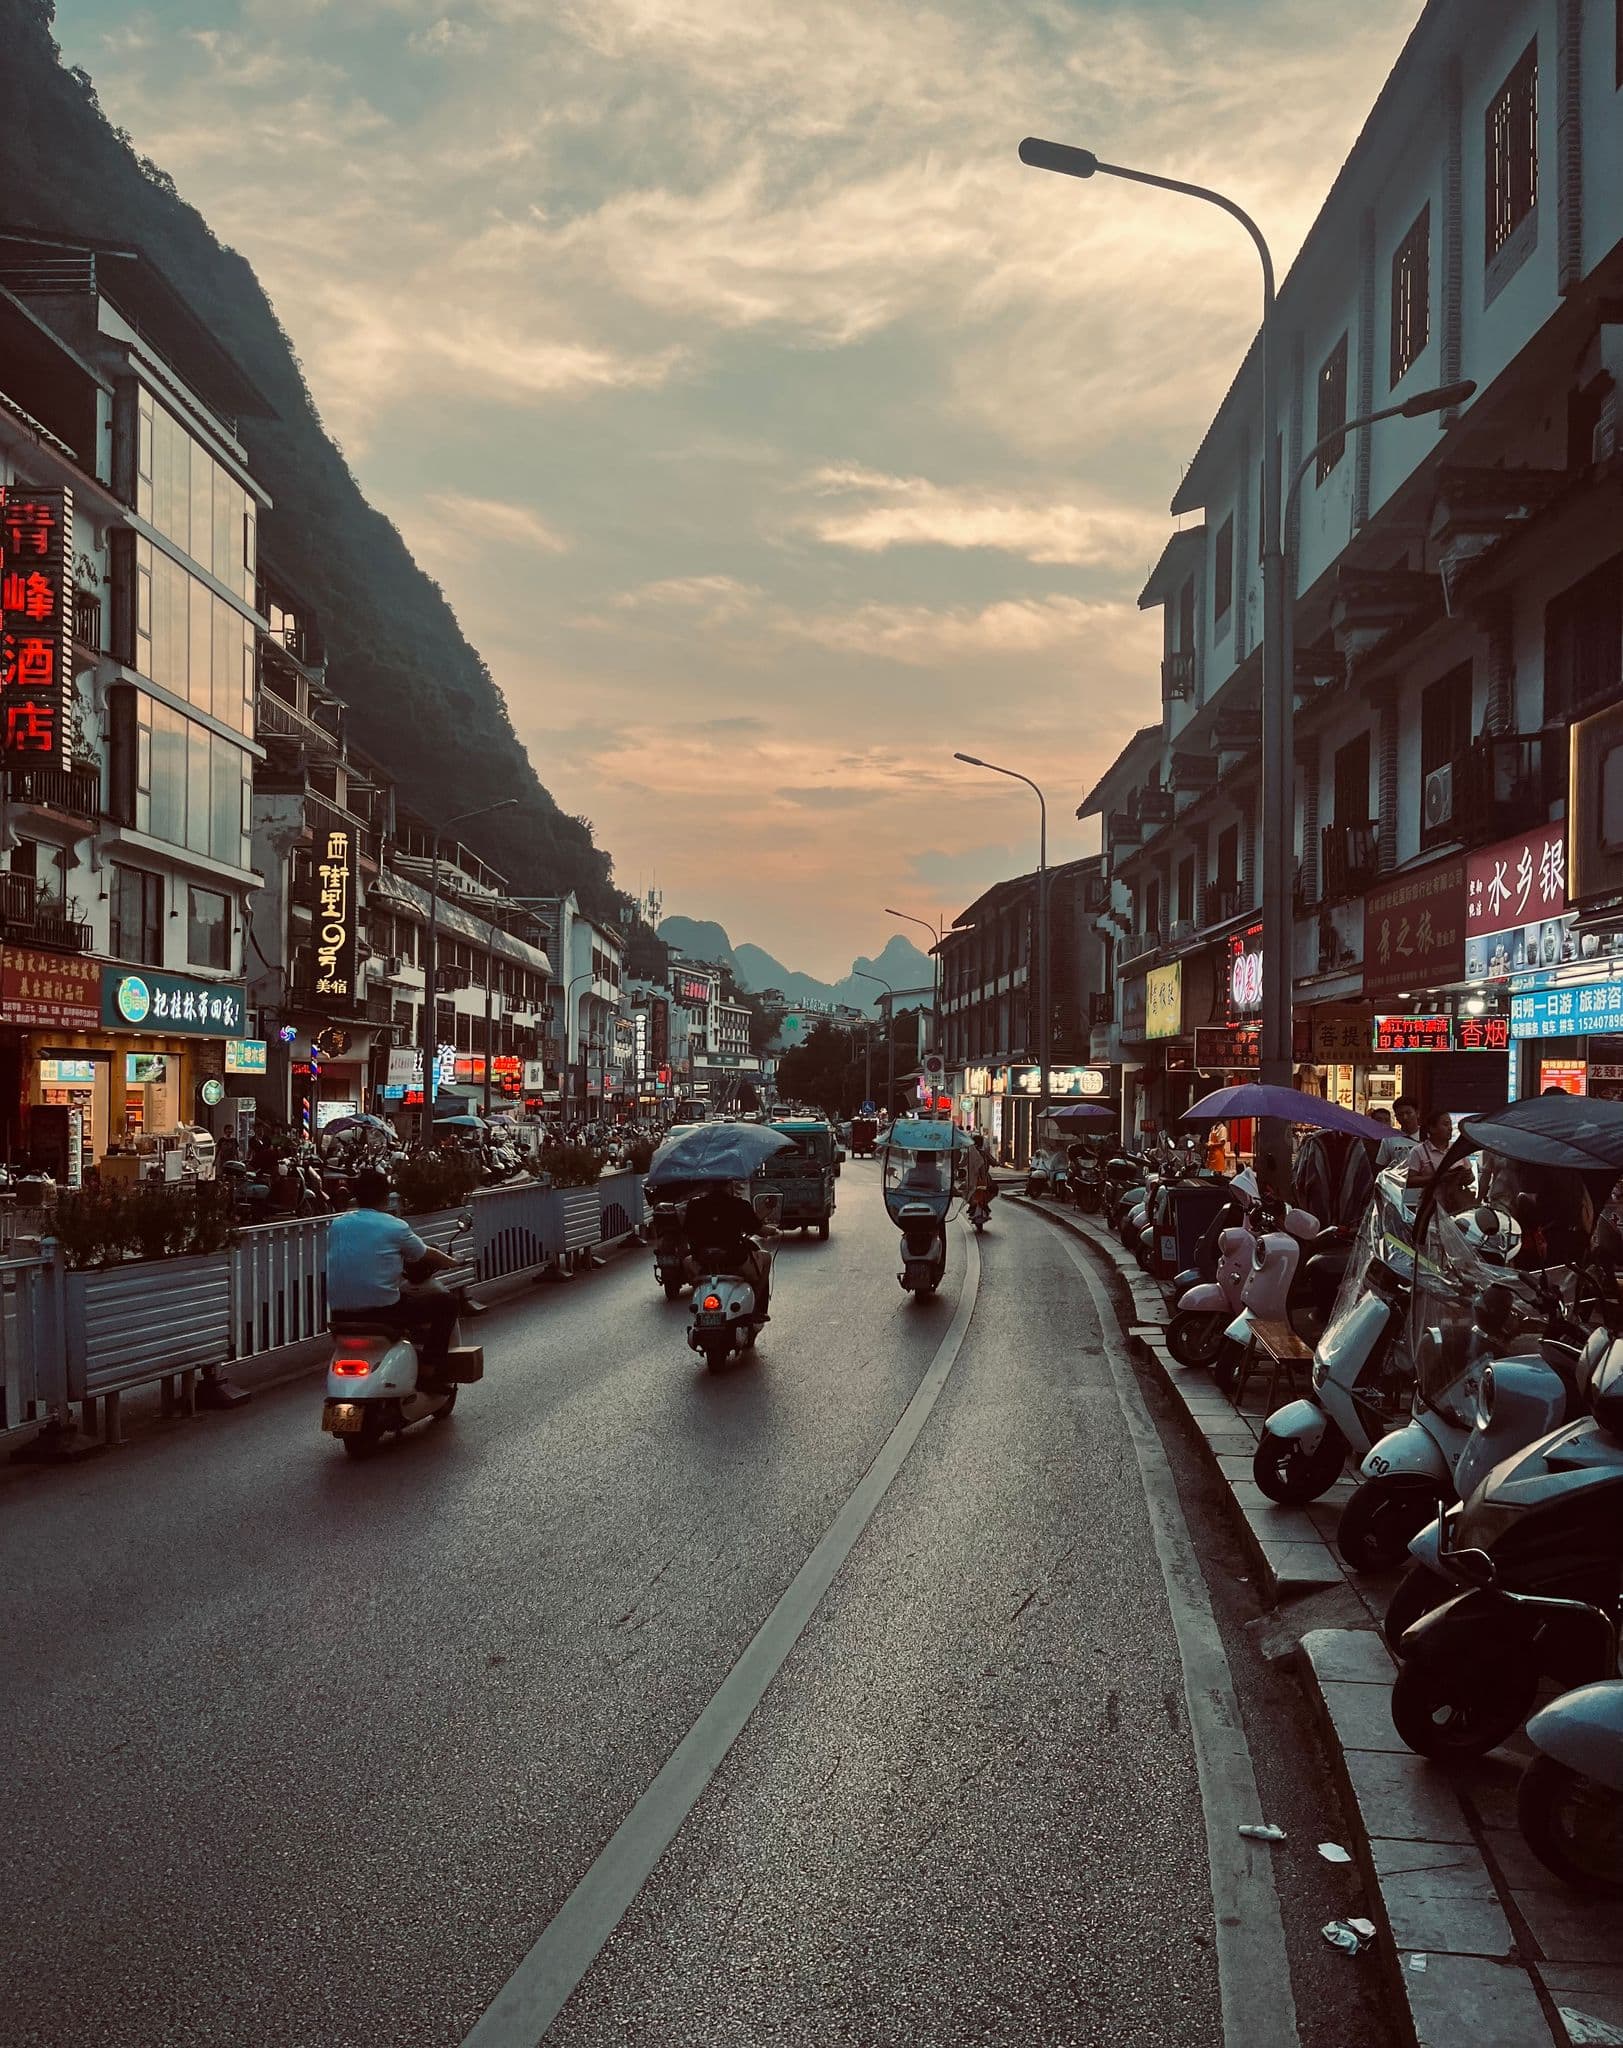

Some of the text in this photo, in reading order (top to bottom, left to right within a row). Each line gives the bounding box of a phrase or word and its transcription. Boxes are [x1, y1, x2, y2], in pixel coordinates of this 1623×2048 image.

[1487, 839, 1564, 917] 水乡银
[1511, 986, 1623, 1019] 阳朔一日游 旅游咨
[1461, 1019, 1508, 1048] 香烟
[1541, 1021, 1557, 1034] 包车
[1338, 1065, 1352, 1104] 雪花
